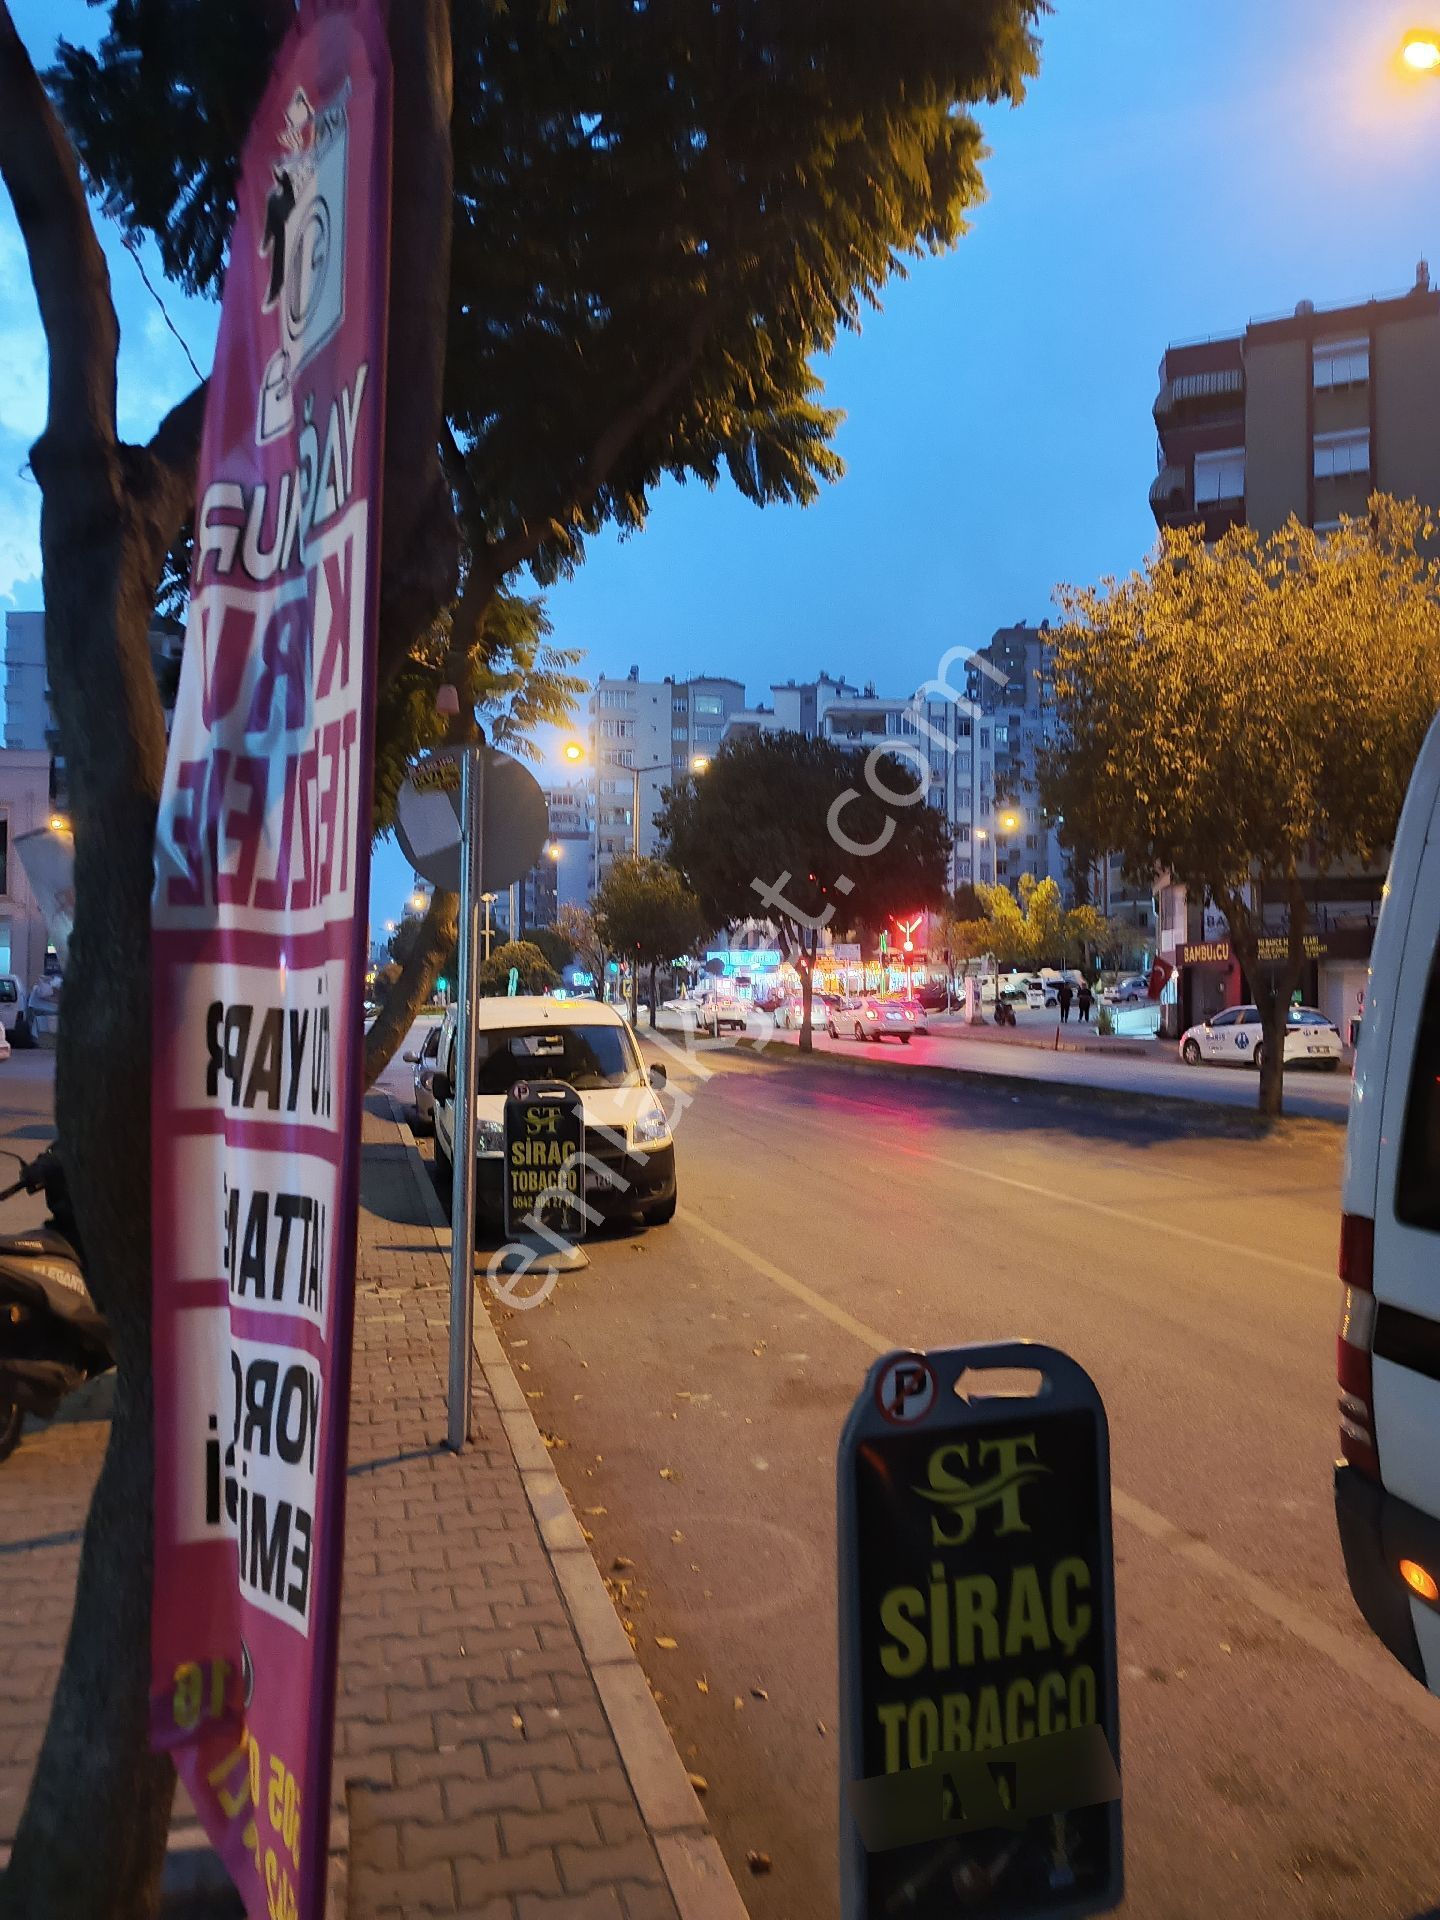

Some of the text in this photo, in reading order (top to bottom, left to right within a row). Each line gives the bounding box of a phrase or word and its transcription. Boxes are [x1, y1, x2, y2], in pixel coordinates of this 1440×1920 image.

[511, 1170, 577, 1193] TOBACCO
[879, 1556, 1093, 1679] SİRAÇ
[876, 1664, 1097, 1776] TOBACCO
